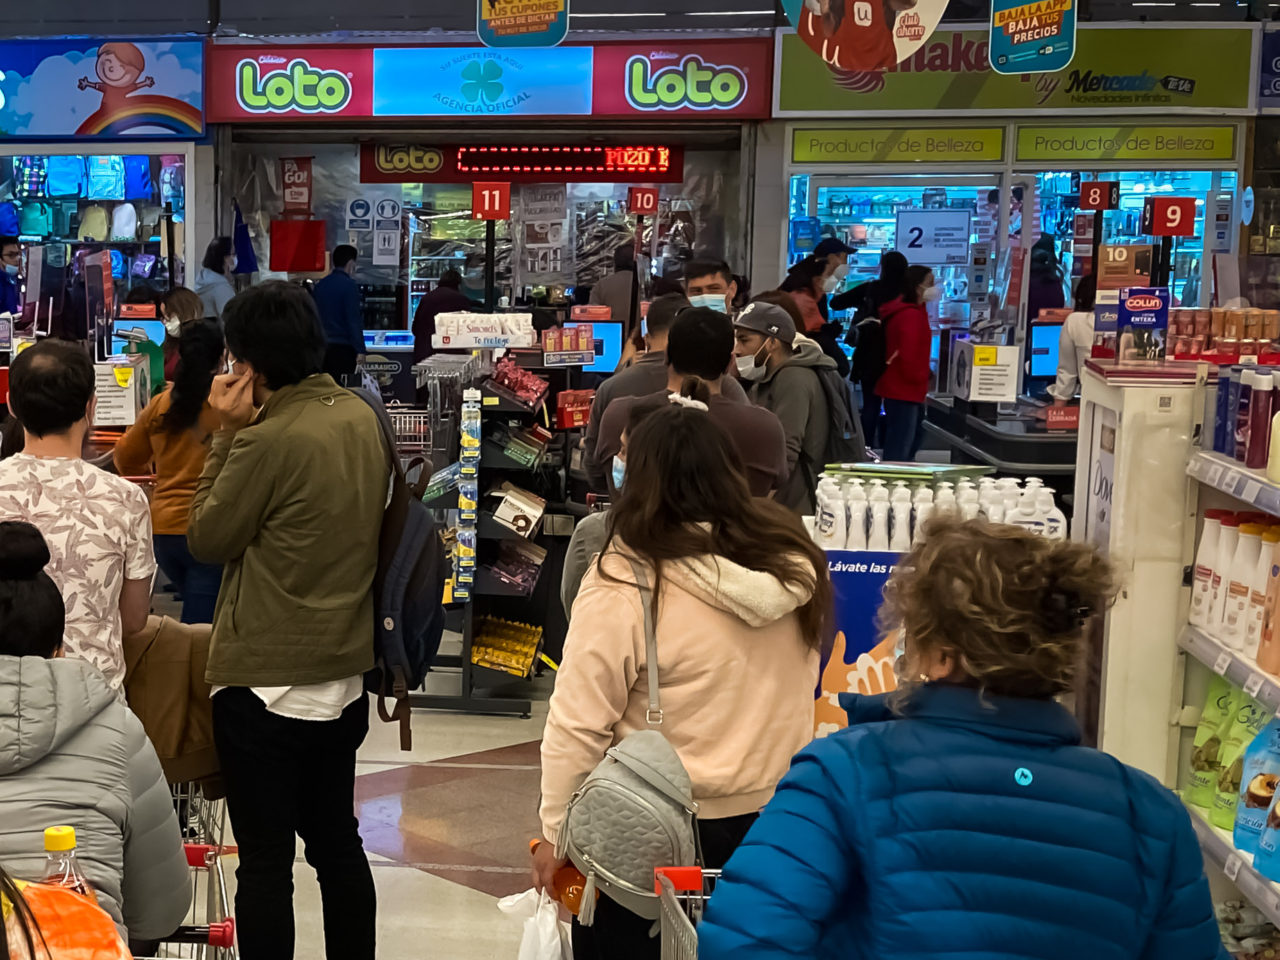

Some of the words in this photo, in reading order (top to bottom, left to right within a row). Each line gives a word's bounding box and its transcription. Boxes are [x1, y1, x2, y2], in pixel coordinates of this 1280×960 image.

[510, 1, 559, 15] CUPONES
[999, 6, 1026, 24] BAJA
[1028, 4, 1042, 16] LA
[490, 18, 515, 27] ANTES
[901, 13, 920, 26] club
[1008, 16, 1039, 34] BAJA
[1042, 12, 1060, 24] TUS
[897, 25, 925, 38] ahorro
[1014, 25, 1058, 44] PRECIOS
[239, 61, 349, 110] Loto
[628, 57, 745, 108] Loto
[1034, 72, 1061, 105] by
[1064, 69, 1158, 94] Mercado
[432, 92, 484, 113] AGENCIA
[486, 91, 533, 113] OFICIAL
[897, 137, 921, 153] de
[925, 137, 985, 153] Belleza
[1035, 136, 1121, 151] Productos
[1126, 136, 1151, 151] de
[1155, 135, 1215, 151] Belleza
[378, 145, 441, 170] Loto
[606, 151, 651, 166] POZO
[481, 189, 501, 212] 11
[635, 193, 654, 210] 10
[1088, 187, 1101, 206] 8
[1111, 186, 1118, 205] 8
[1144, 204, 1151, 226] 9
[1165, 205, 1182, 228] 9
[907, 226, 924, 249] 2
[1106, 247, 1128, 262] 10
[828, 560, 868, 574] Lávate
[869, 562, 887, 574] las
